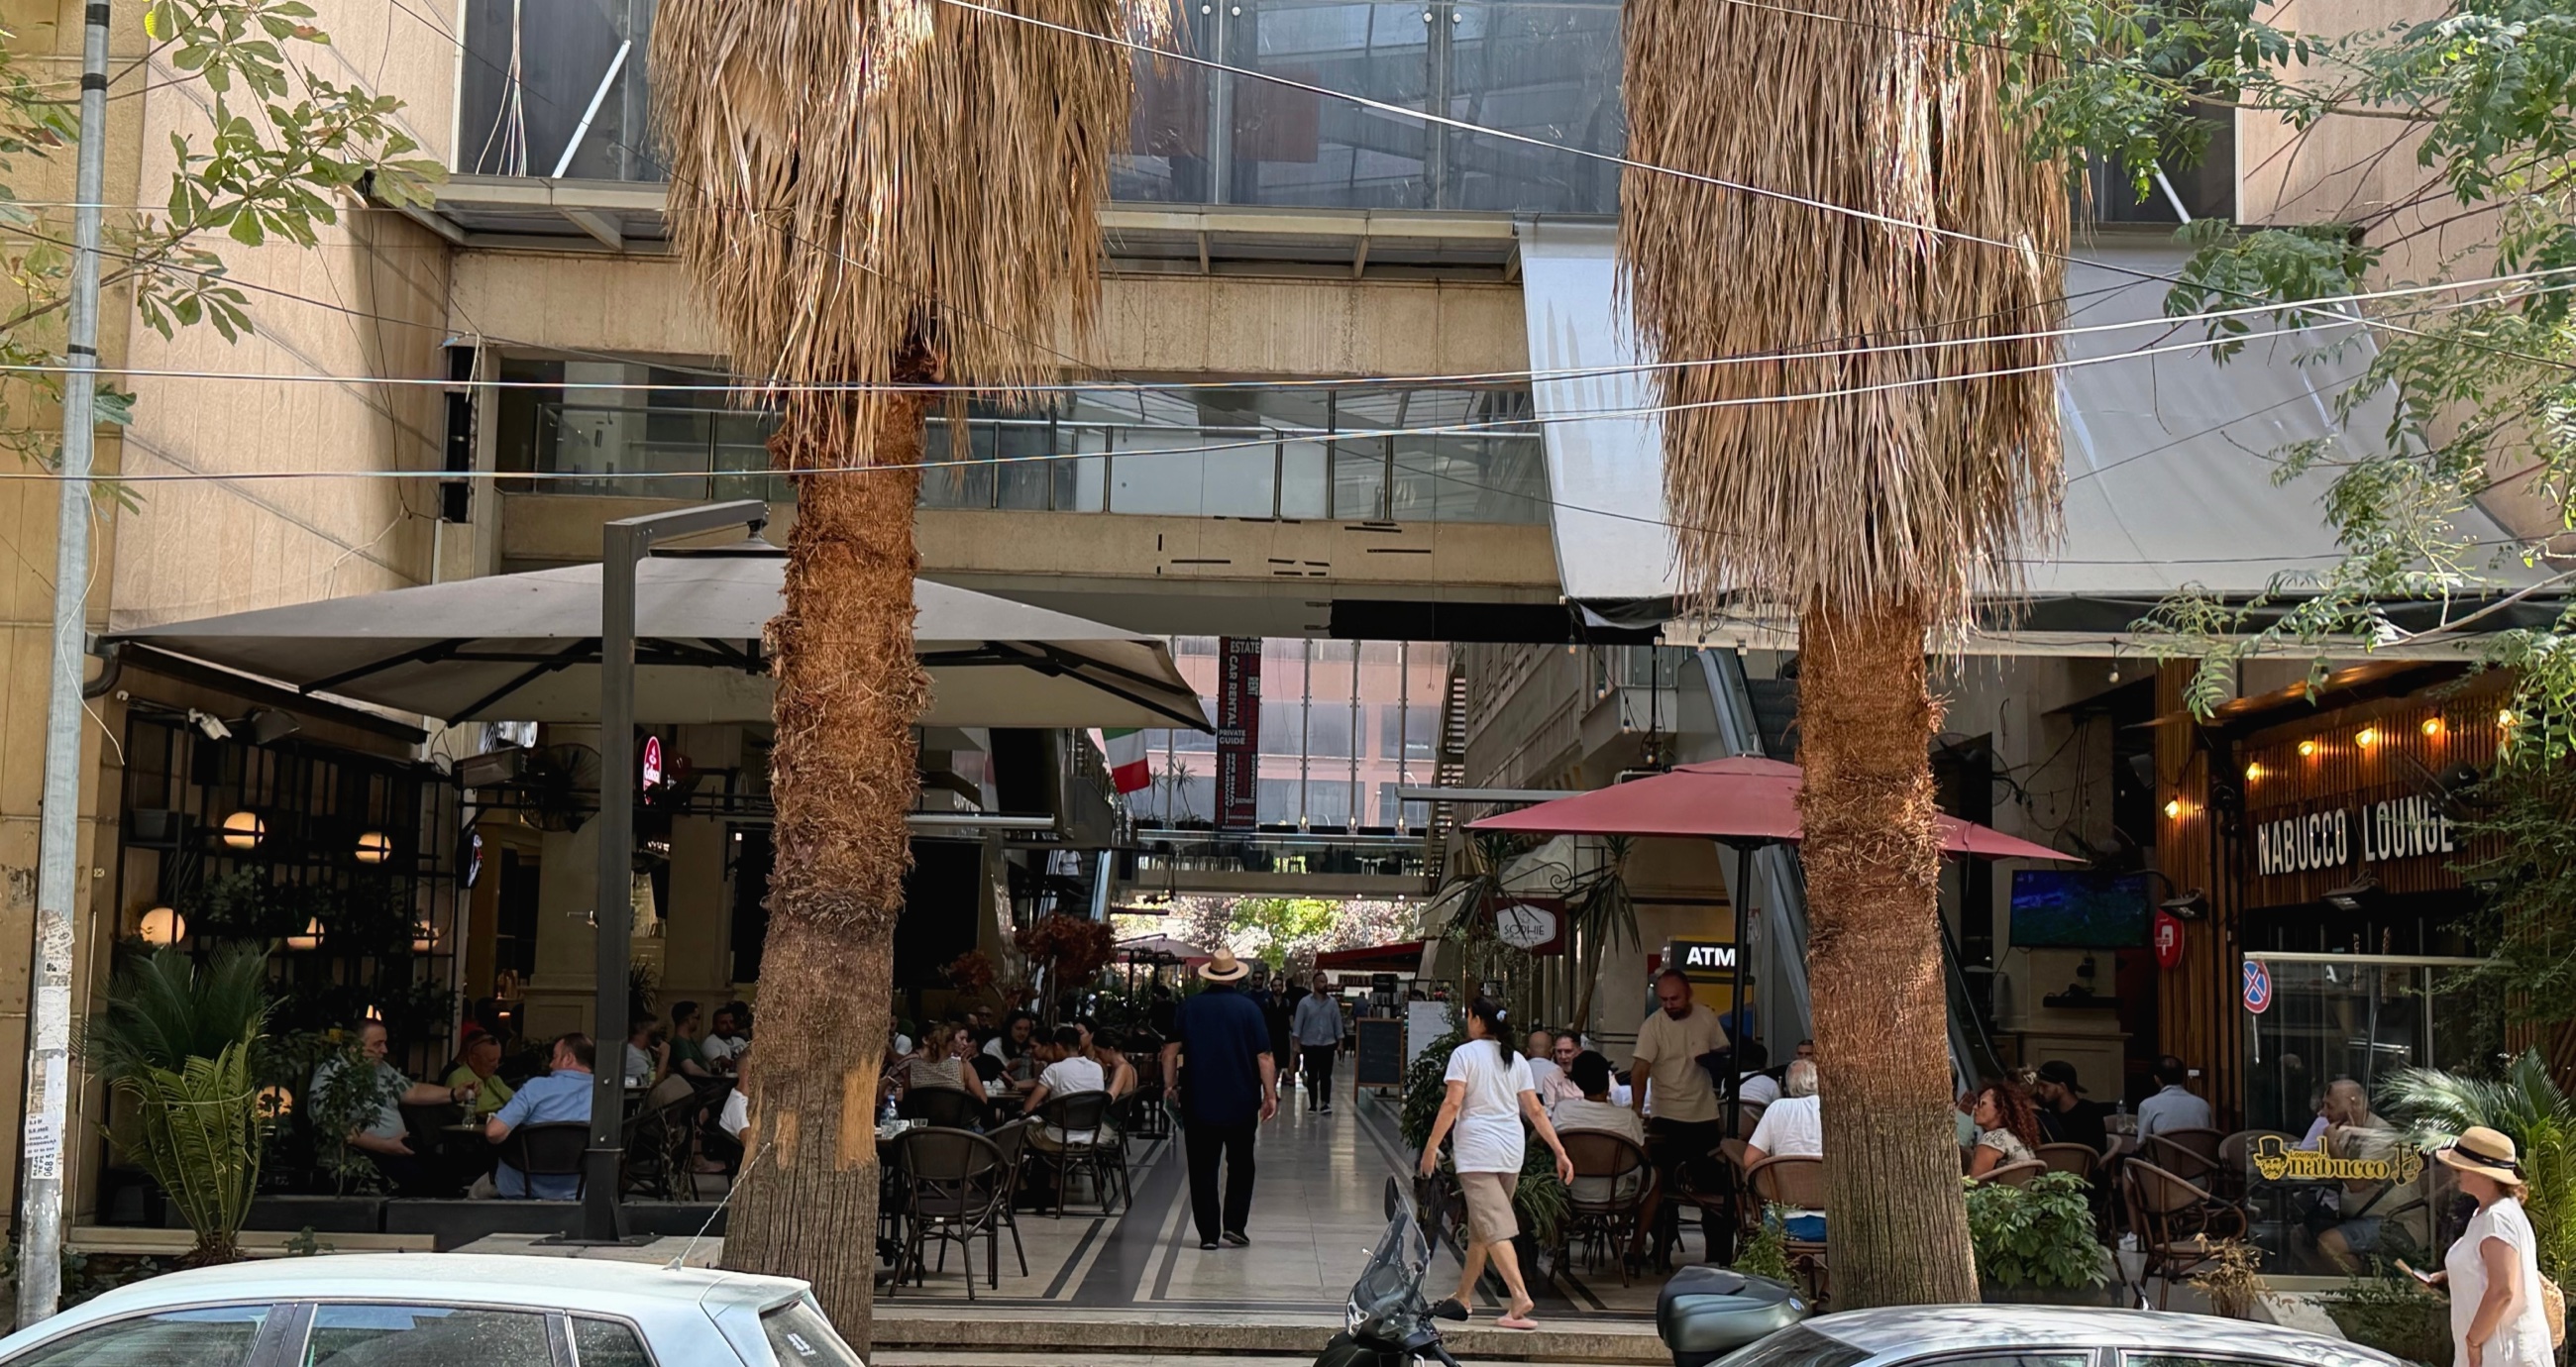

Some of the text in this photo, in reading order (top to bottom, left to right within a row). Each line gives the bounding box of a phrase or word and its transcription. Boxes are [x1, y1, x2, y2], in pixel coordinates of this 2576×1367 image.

[1230, 641, 1260, 654] ESTATE
[1228, 655, 1238, 728] CAR RENTAL
[1247, 676, 1259, 696] RENT
[1219, 736, 1245, 745] GUIDE
[2257, 794, 2454, 876] NABUCCO LOUNGE
[1504, 923, 1546, 936] SOPHIE
[1686, 946, 1736, 967] ATM
[2289, 1136, 2390, 1178] nabucco
